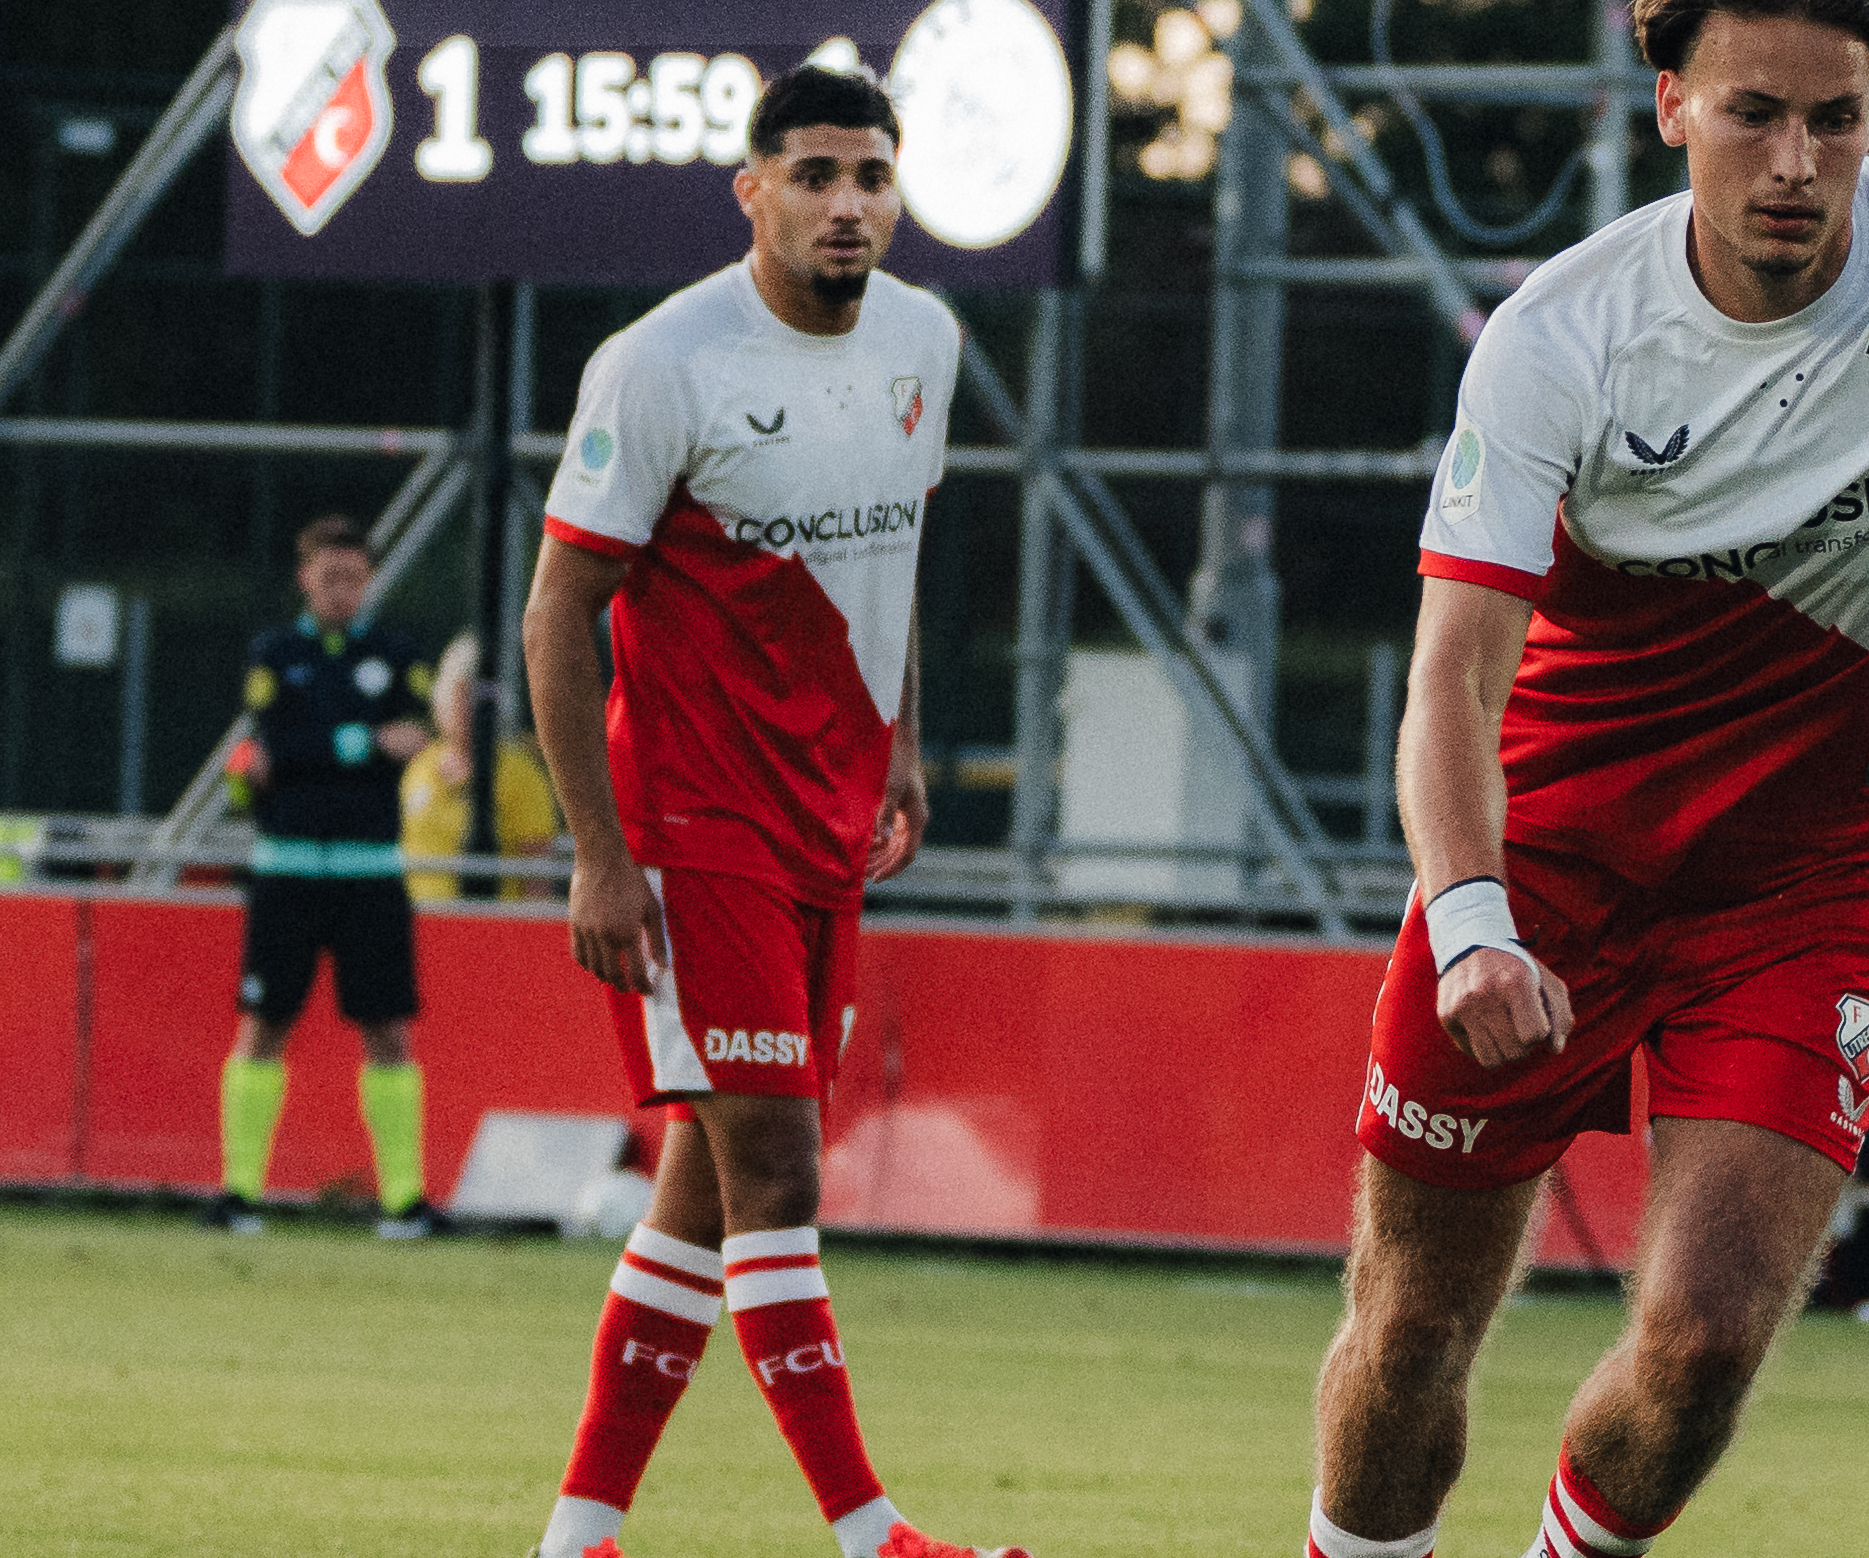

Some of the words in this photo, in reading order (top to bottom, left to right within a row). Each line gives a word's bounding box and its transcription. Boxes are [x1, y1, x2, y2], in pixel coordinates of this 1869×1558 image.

[415, 35, 493, 182] 1
[522, 50, 762, 165] 15:59
[735, 500, 918, 548] CONCLUSION
[704, 1027, 808, 1067] DASSY
[1369, 1061, 1488, 1154] DASSY
